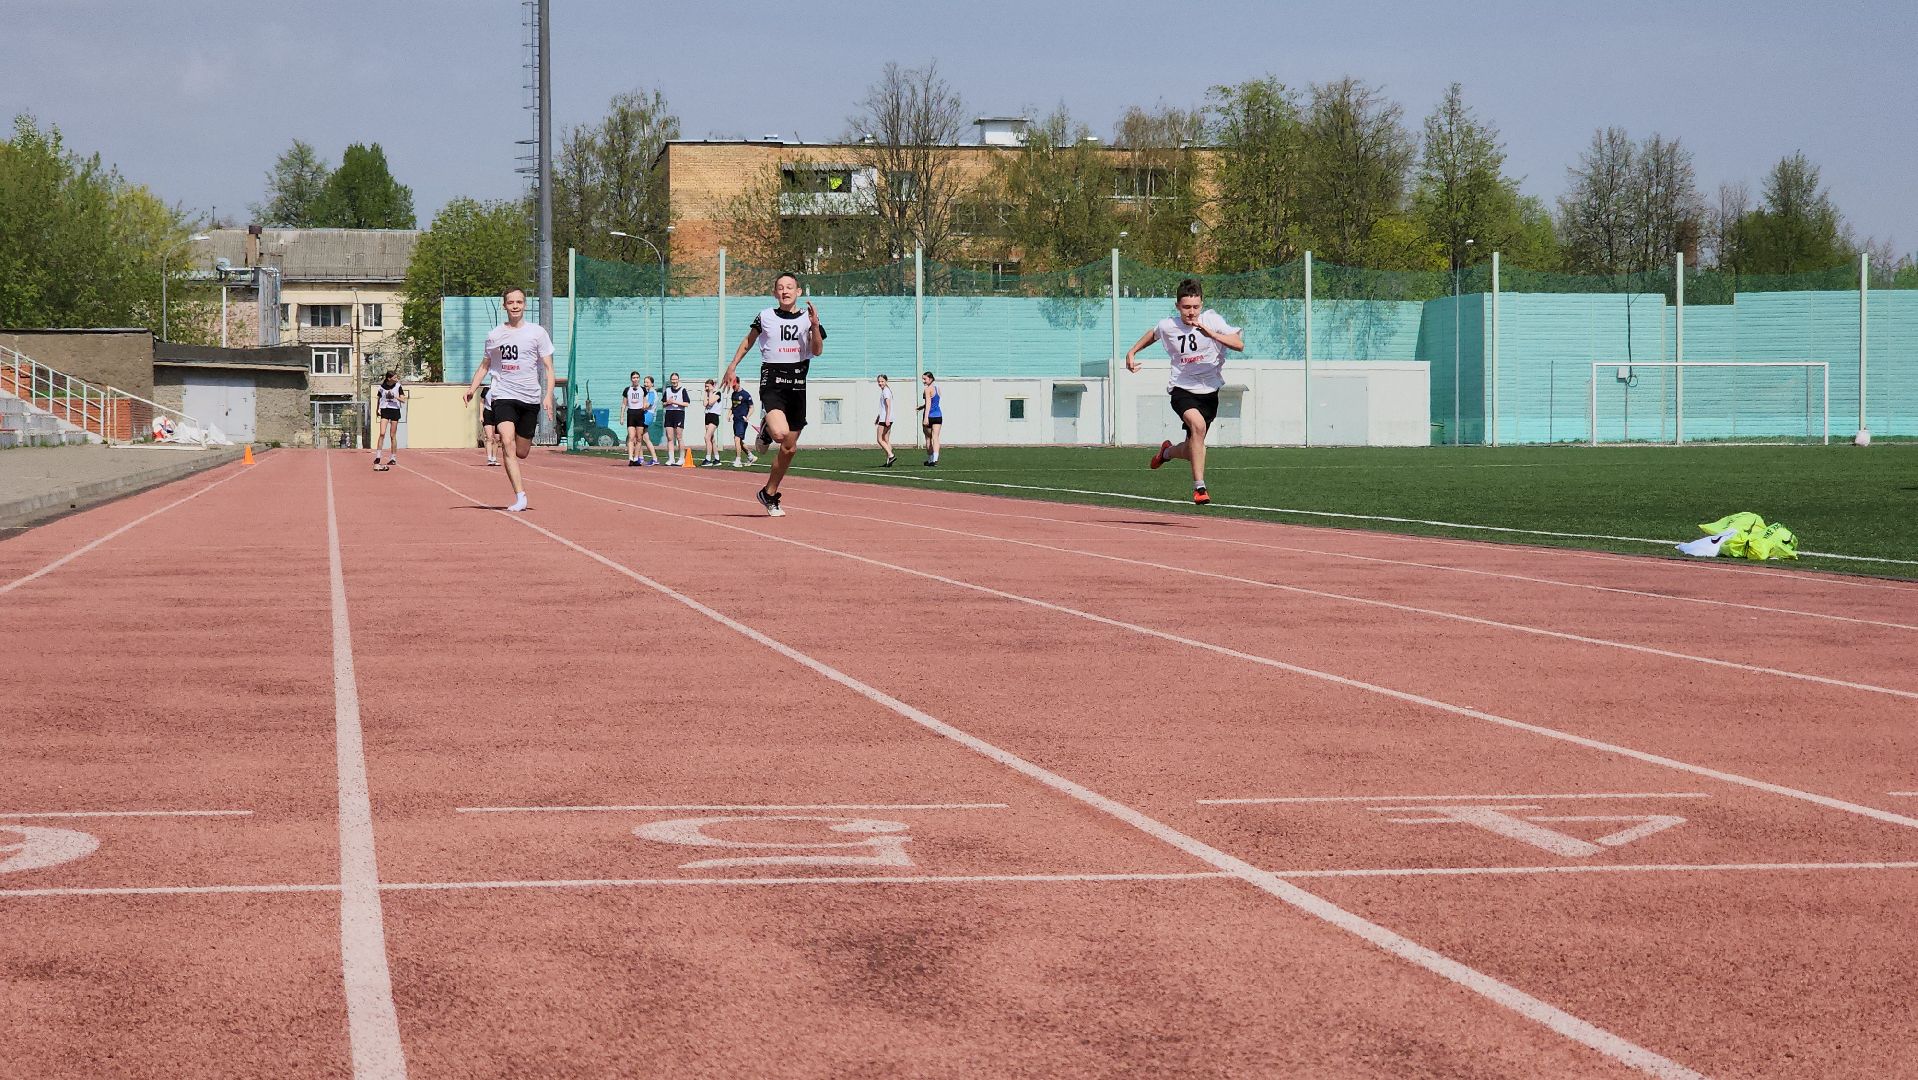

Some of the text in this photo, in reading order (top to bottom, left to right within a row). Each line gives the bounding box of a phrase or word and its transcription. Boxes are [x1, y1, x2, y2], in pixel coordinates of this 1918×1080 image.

[780, 325, 798, 341] 162
[1177, 333, 1198, 354] 78
[500, 344, 518, 360] 239
[1366, 804, 1690, 857] 4
[631, 815, 916, 869] 5
